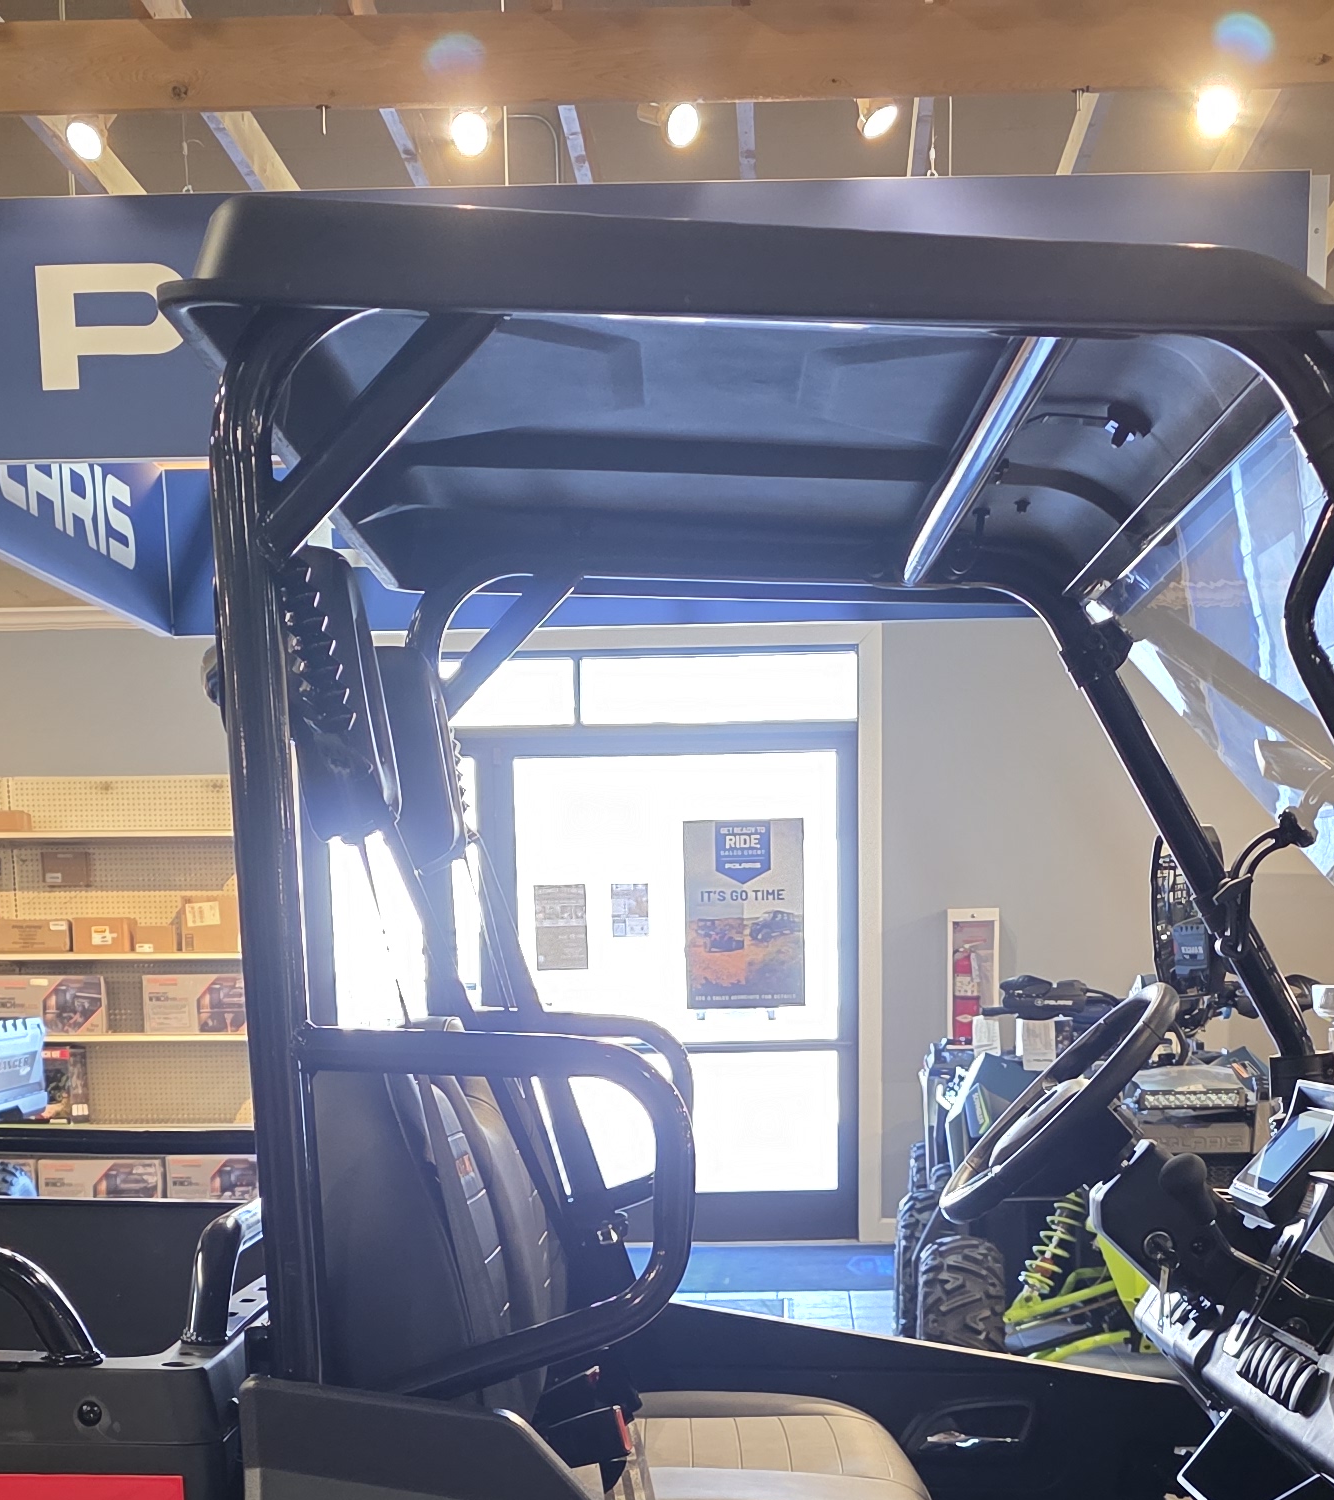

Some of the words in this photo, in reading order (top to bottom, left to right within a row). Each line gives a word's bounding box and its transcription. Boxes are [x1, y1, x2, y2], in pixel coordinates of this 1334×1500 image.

[725, 834, 761, 849] RIDE
[700, 890, 727, 903] IT'S
[730, 889, 749, 902] GO
[752, 888, 786, 902] TIME
